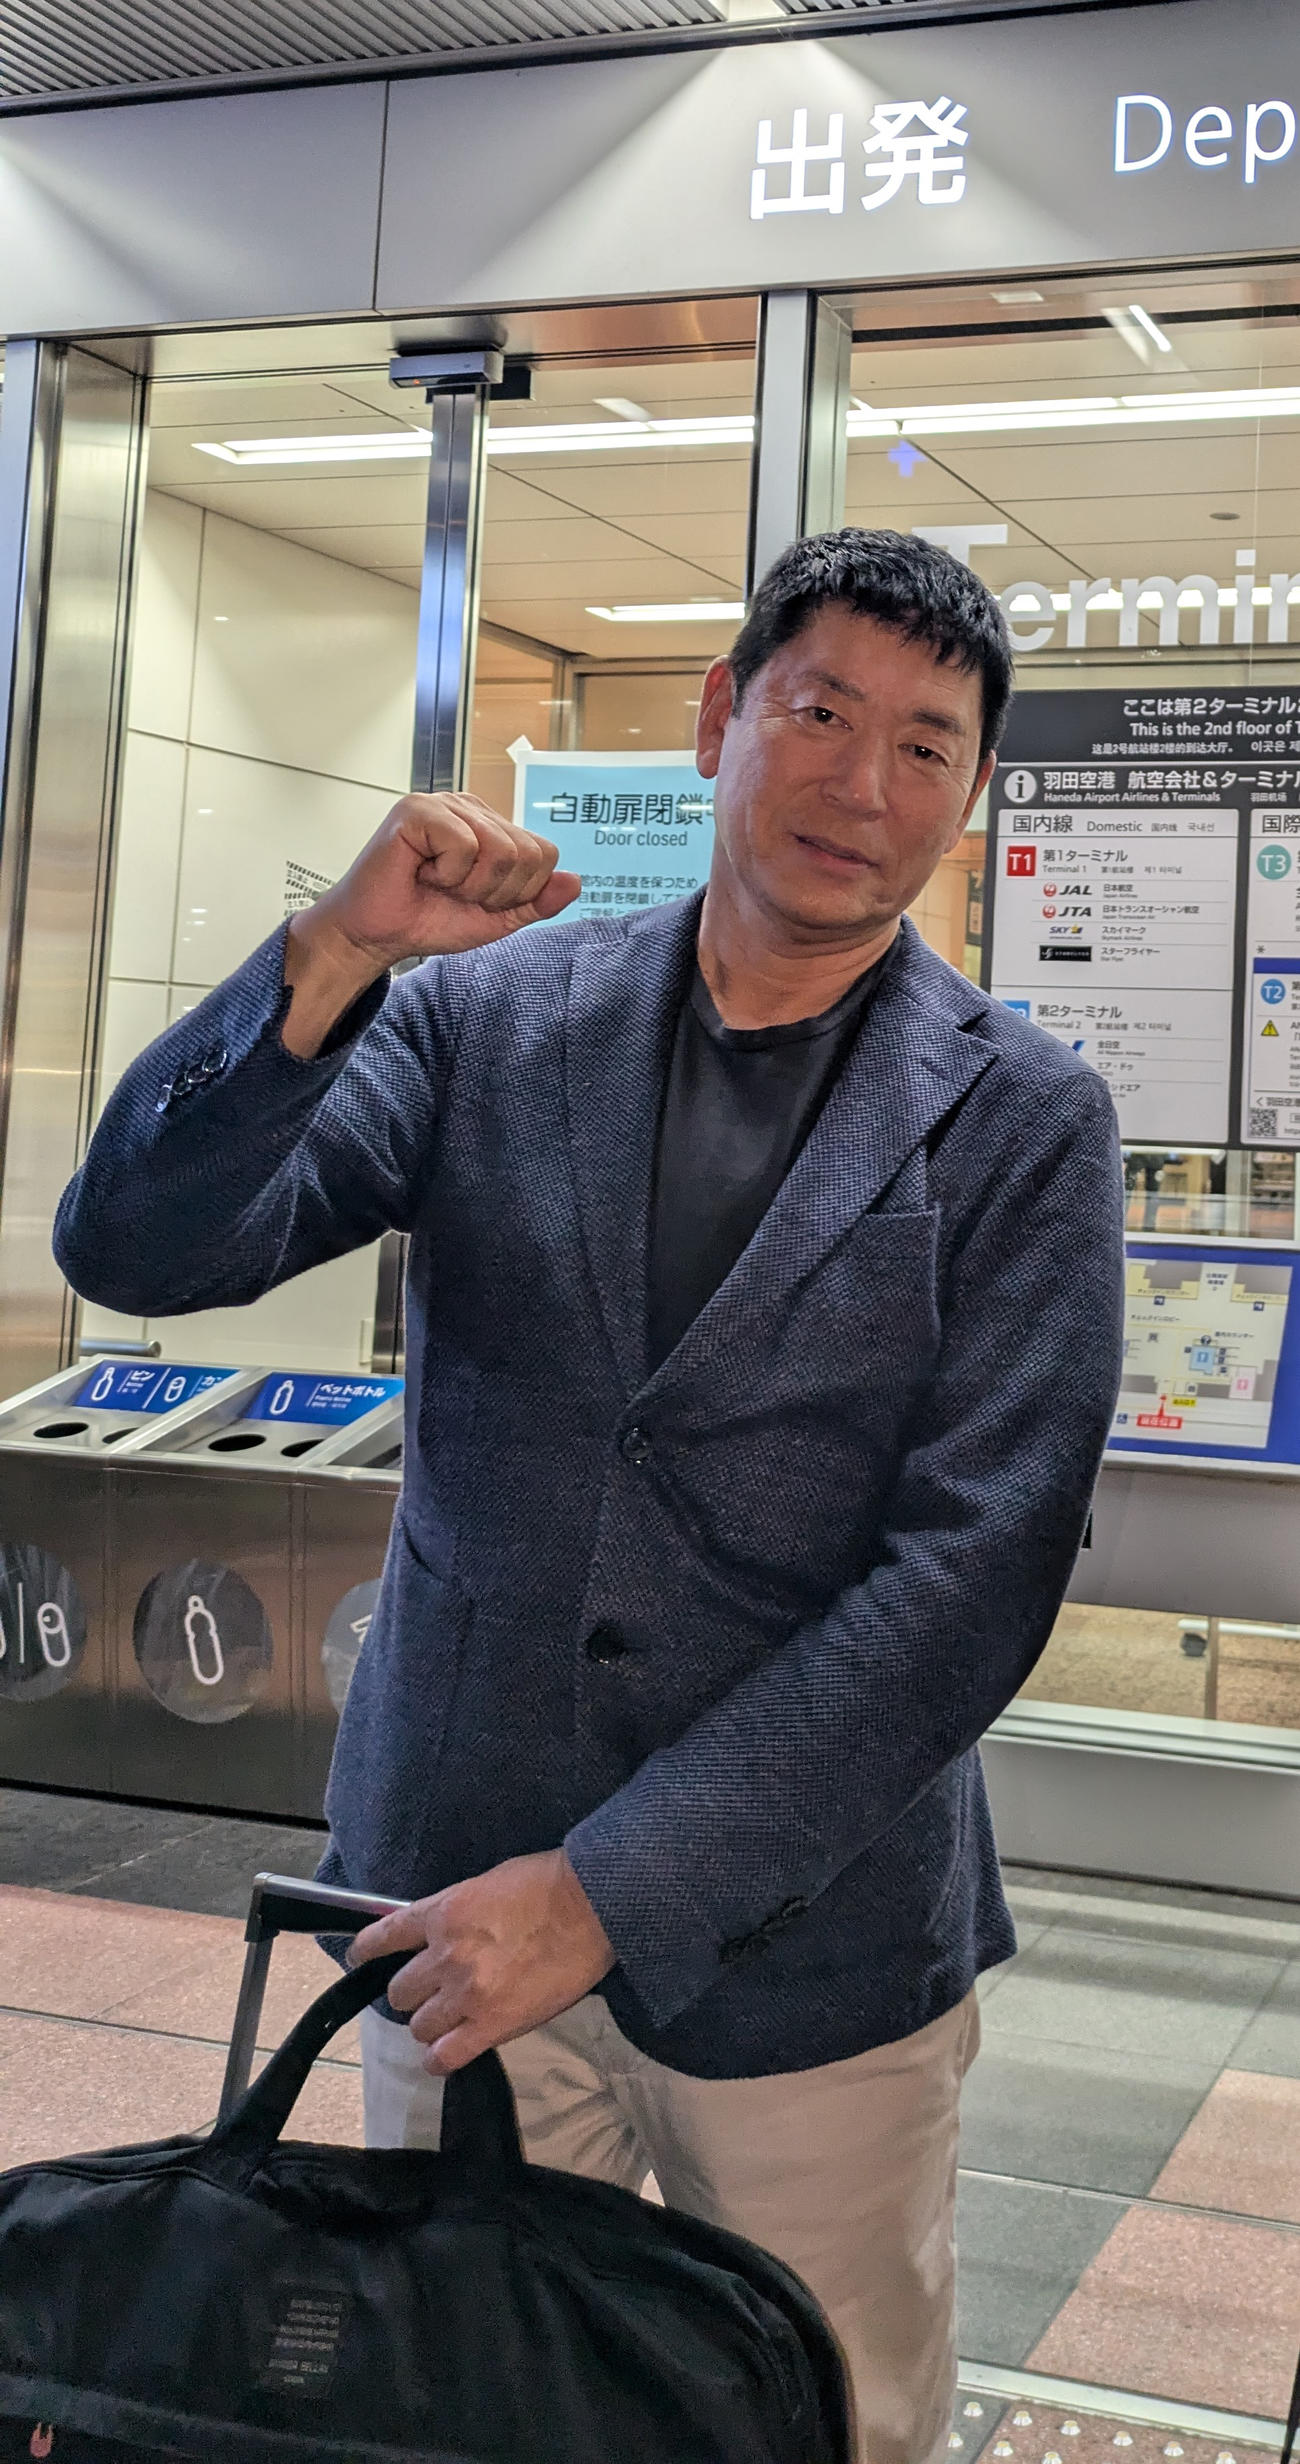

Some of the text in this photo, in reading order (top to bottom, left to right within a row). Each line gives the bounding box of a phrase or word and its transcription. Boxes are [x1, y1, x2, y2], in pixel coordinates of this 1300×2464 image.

[1113, 94, 1297, 184] Dep
[750, 96, 969, 220] 出発
[1123, 696, 1300, 717] ここは第2ターミナル
[1129, 722, 1159, 736] This
[1161, 722, 1173, 736] is
[1176, 722, 1200, 736] the
[1204, 721, 1232, 735] 2nd
[1235, 720, 1272, 735] floor
[1275, 720, 1293, 734] of
[1043, 771, 1115, 790] 羽田空港
[1043, 792, 1221, 803] Haneda Airport Airlines & Terminals
[1013, 815, 1073, 833] 国内線
[1087, 821, 1143, 832] Domestic
[1262, 814, 1300, 833] 国際
[594, 829, 688, 846] Door closed
[1009, 853, 1032, 871] T1
[1043, 850, 1128, 862] 第1ターミナル
[1043, 865, 1080, 873] Terminal
[1261, 855, 1287, 873] T3
[1059, 885, 1092, 895] JAL
[1059, 906, 1092, 917] JTA
[1049, 926, 1069, 934] SKY
[1102, 926, 1146, 935] スカイマーク
[1263, 985, 1283, 999] T2
[1037, 1005, 1122, 1018] 第2ターミナル
[1037, 1020, 1081, 1029] Terminal 2
[131, 1370, 156, 1381] ビン
[320, 1383, 386, 1398] ペットボトル
